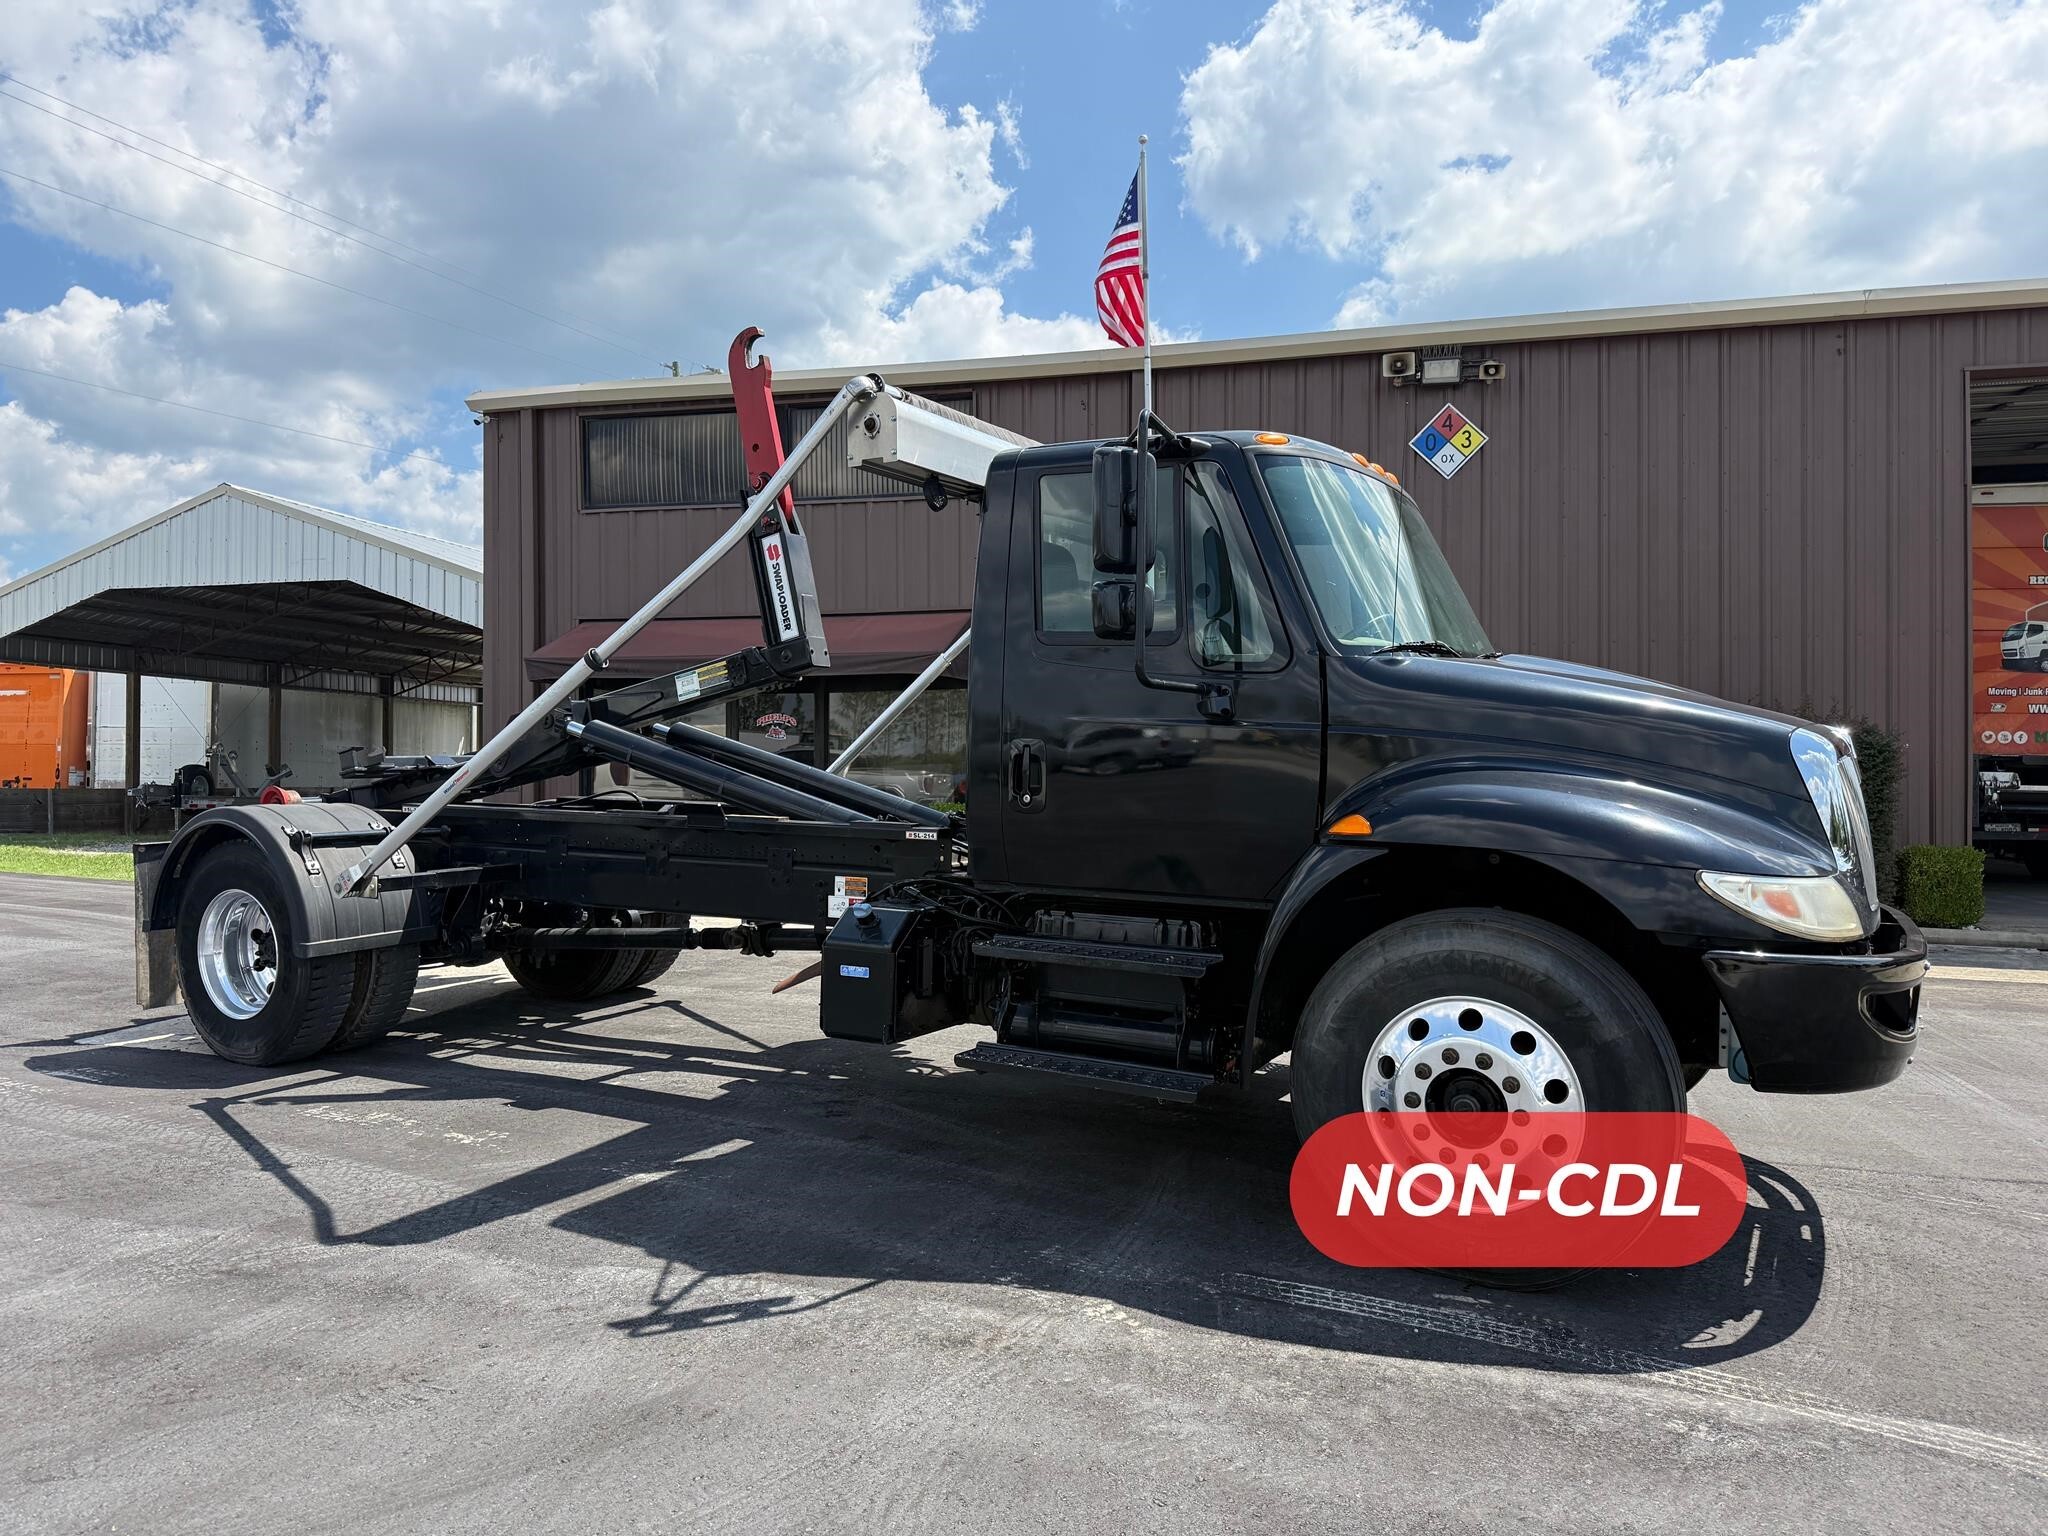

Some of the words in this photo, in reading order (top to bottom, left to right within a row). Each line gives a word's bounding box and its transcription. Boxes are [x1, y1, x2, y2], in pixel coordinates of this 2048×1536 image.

[1441, 413, 1453, 432] 4
[1425, 433, 1437, 451] 0
[1461, 430, 1472, 449] 3
[1441, 454, 1455, 464] OX
[772, 562, 792, 631] SWAPLOADER
[1988, 687, 2017, 697] Moving
[2023, 687, 2043, 696] Junk
